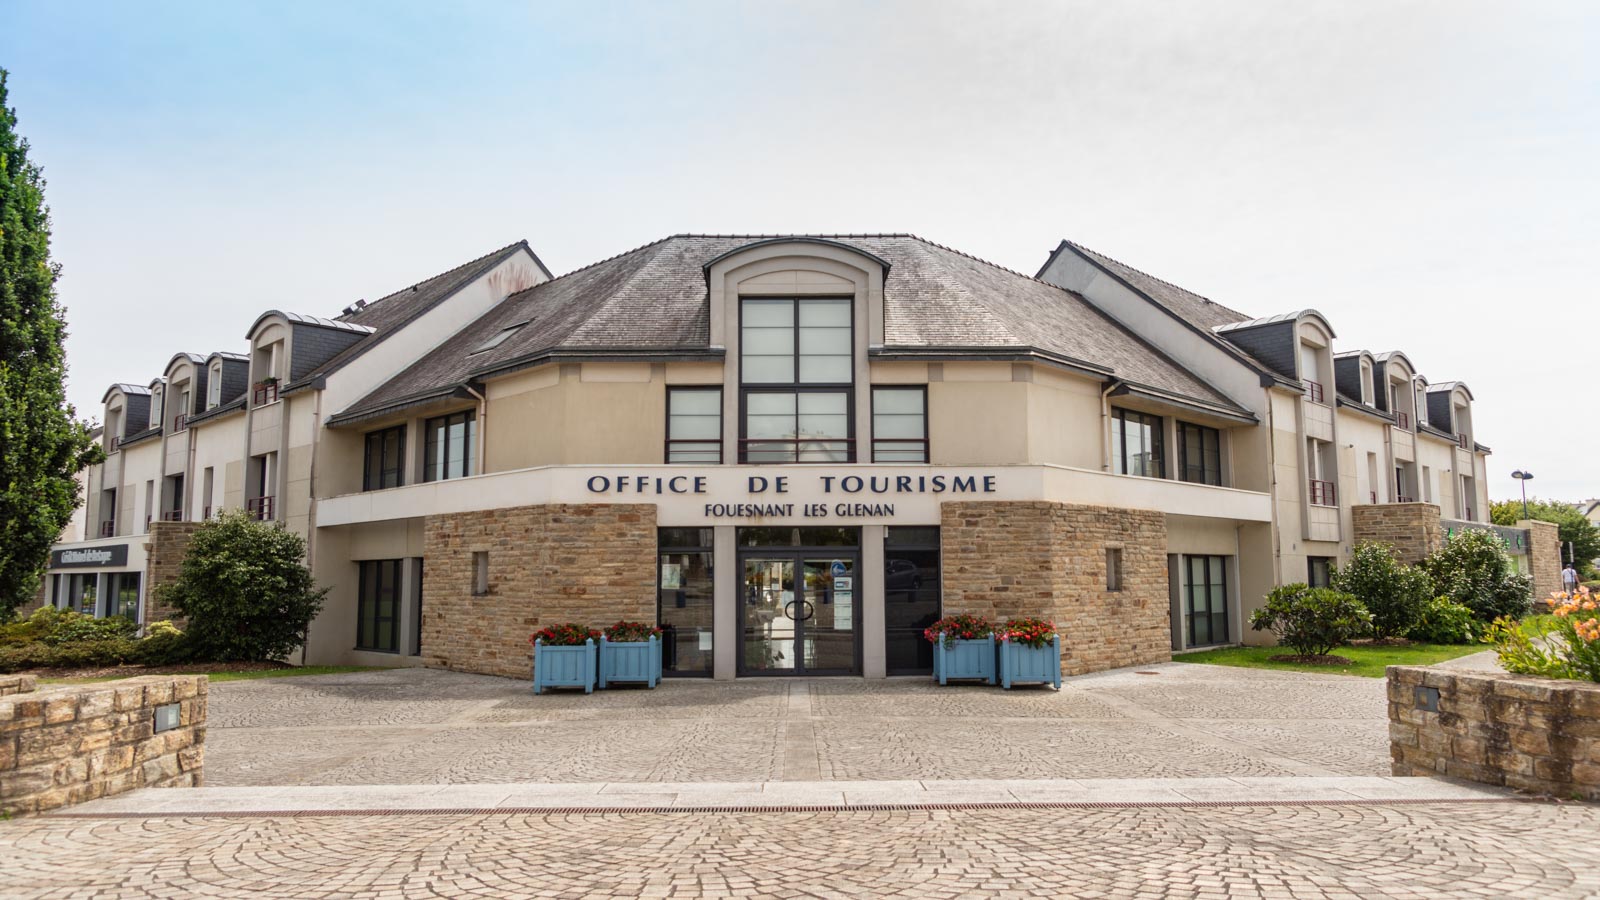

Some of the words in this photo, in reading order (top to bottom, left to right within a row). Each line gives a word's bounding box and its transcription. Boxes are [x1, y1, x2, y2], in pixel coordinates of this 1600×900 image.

[587, 475, 706, 494] OFFICE
[748, 476, 789, 494] DE
[819, 475, 996, 494] TOURISME
[705, 503, 795, 518] FOUESNANT
[803, 503, 828, 518] LES
[834, 503, 895, 518] GLENAN
